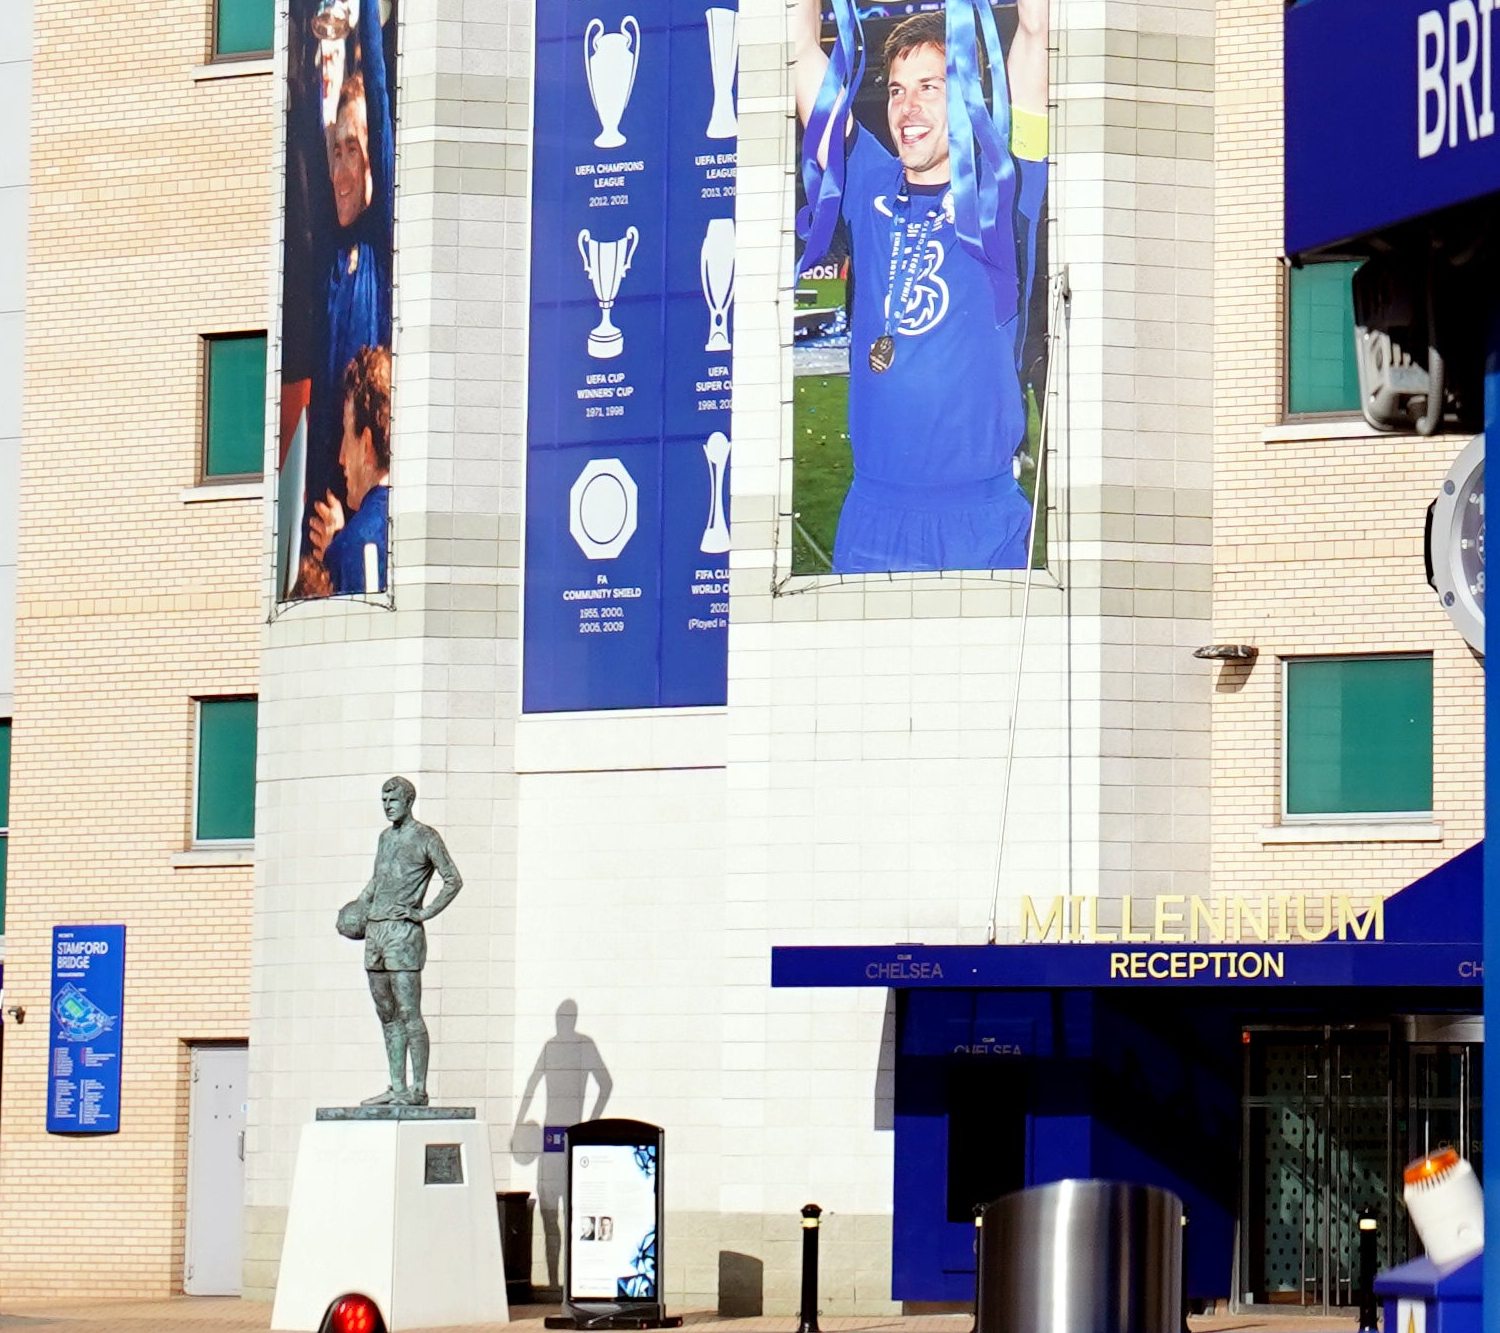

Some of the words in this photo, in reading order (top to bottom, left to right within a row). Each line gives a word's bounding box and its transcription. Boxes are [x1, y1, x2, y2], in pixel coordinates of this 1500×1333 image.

[695, 155, 716, 166] UEFA
[575, 164, 595, 176] UEFA
[596, 161, 644, 174] CHAMPIONS
[706, 167, 736, 180] LEAGUE
[594, 176, 625, 188] LEAGUE
[708, 366, 729, 377] UEFA
[586, 374, 606, 385] UEFA
[607, 373, 625, 384] CUP
[616, 386, 634, 398] CUP
[696, 381, 722, 392] SUPER
[596, 575, 608, 585] FA
[695, 569, 714, 580] FIFA
[563, 589, 612, 601] COMMUNITY
[613, 587, 642, 598] SHIELD
[691, 584, 721, 595] WORLD
[1020, 894, 1385, 941] MILLENNIUM
[57, 941, 108, 955] STAMFORD
[57, 955, 90, 969] BRIDGE
[1111, 951, 1285, 979] RECEPTION
[865, 962, 943, 980] CHELSEA
